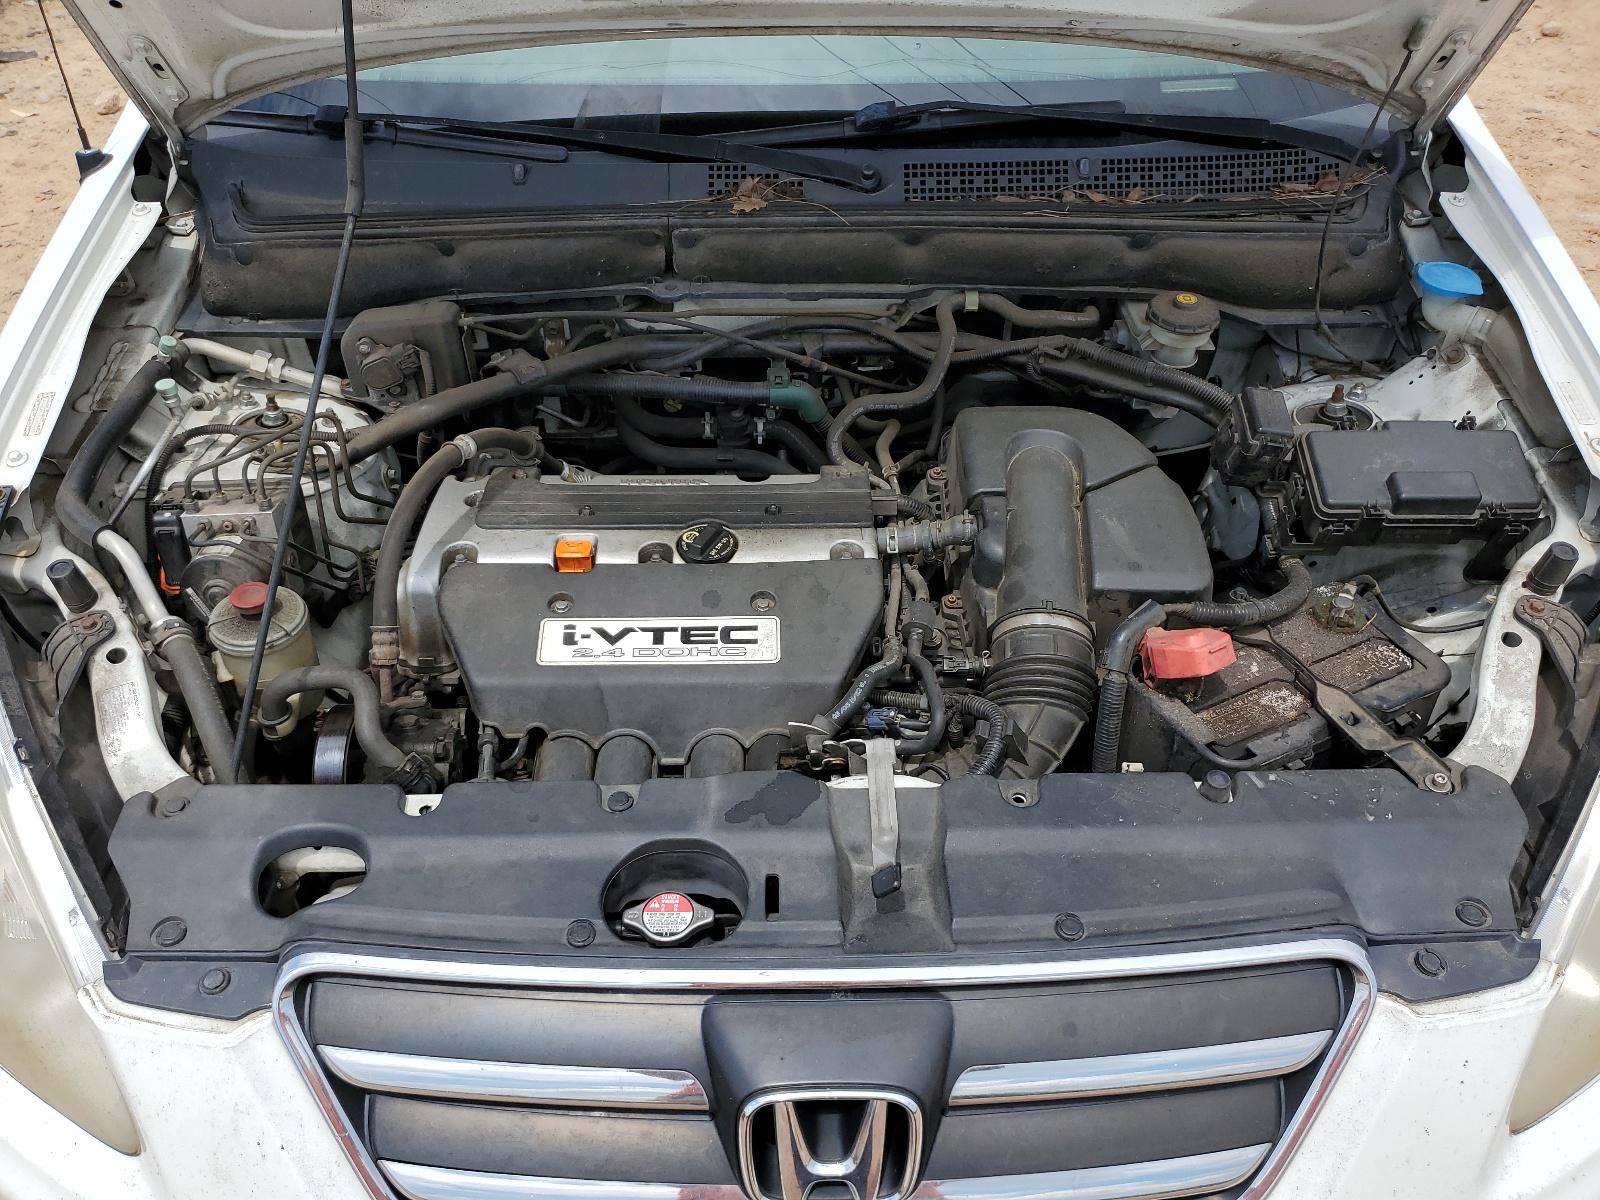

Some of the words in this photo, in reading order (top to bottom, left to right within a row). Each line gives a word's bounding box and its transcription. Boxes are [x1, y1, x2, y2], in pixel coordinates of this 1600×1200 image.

[562, 624, 758, 647] i-VTEC
[572, 647, 625, 659] 2.4
[632, 646, 748, 657] DOHC
